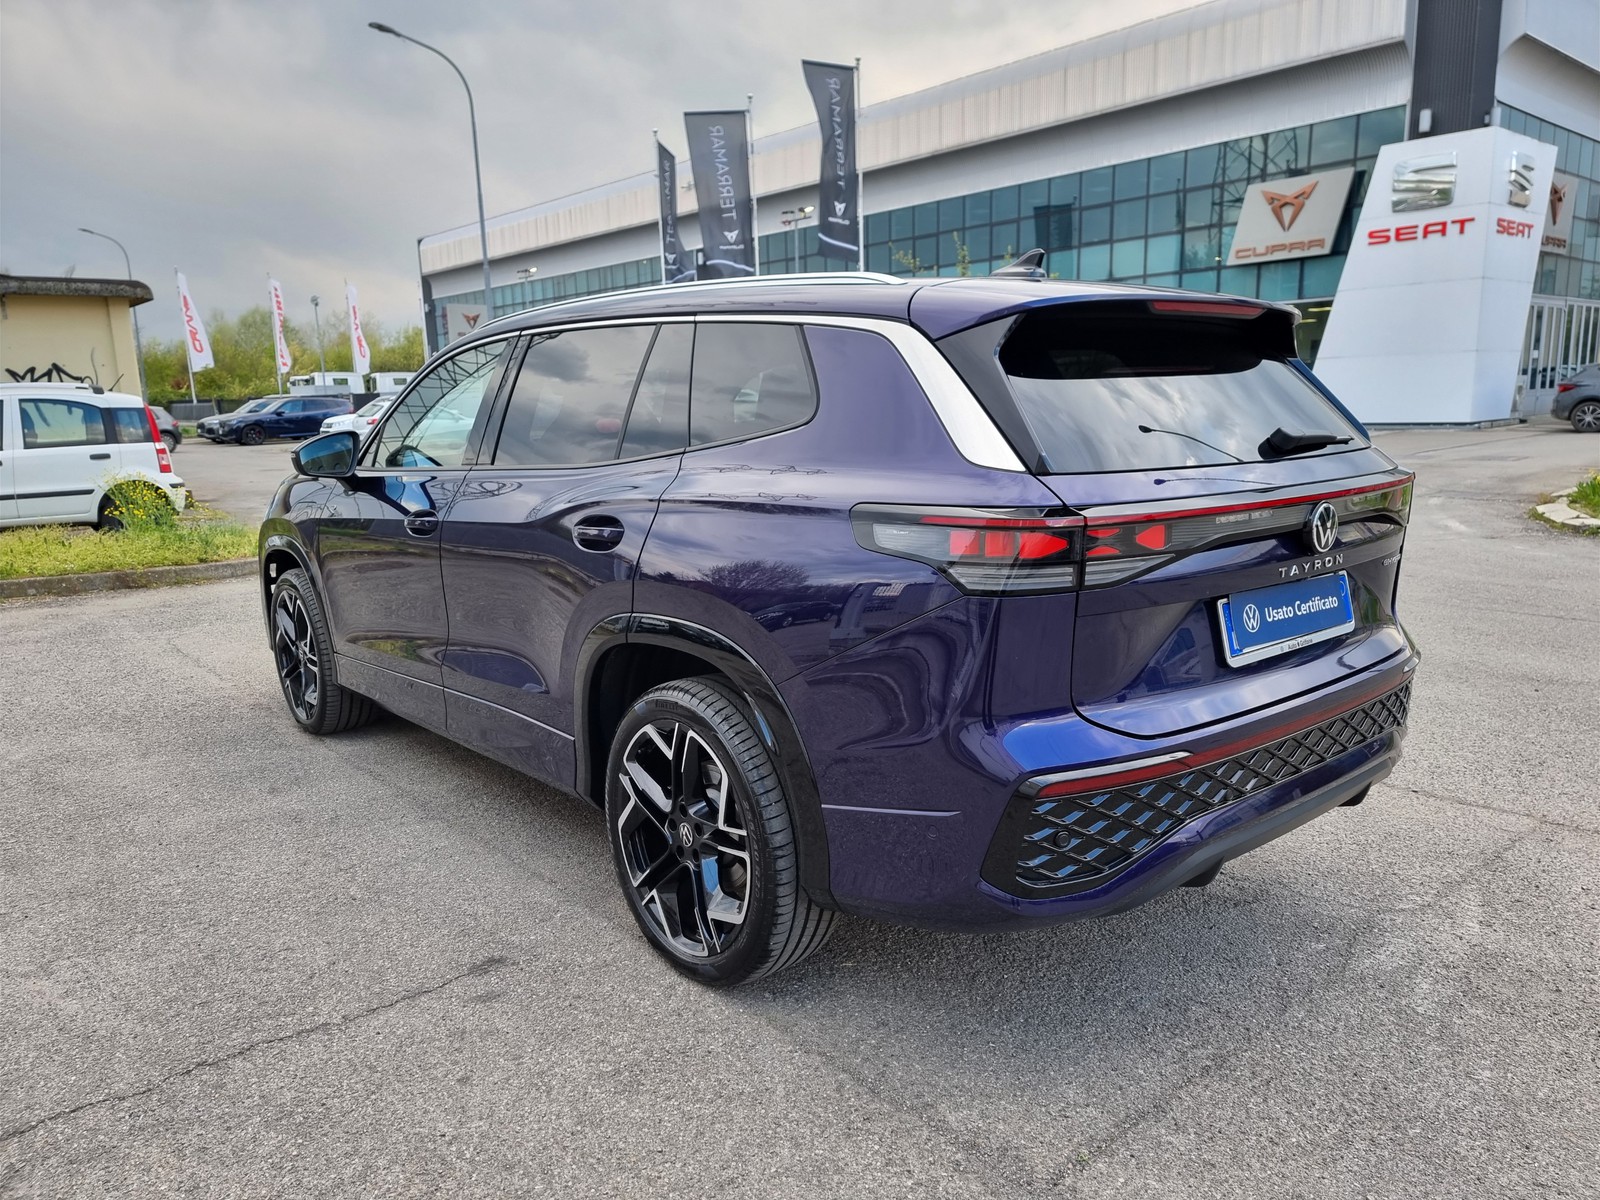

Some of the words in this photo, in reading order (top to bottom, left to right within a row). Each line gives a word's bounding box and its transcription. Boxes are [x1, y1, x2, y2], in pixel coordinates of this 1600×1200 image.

[1367, 217, 1475, 246] SEAT
[1495, 217, 1535, 240] SEAT
[1234, 237, 1326, 260] CUPRA
[1541, 235, 1567, 249] UPRA
[1279, 554, 1344, 578] TAYRON
[1264, 603, 1294, 622] Usato
[1294, 595, 1339, 615] Certificato
